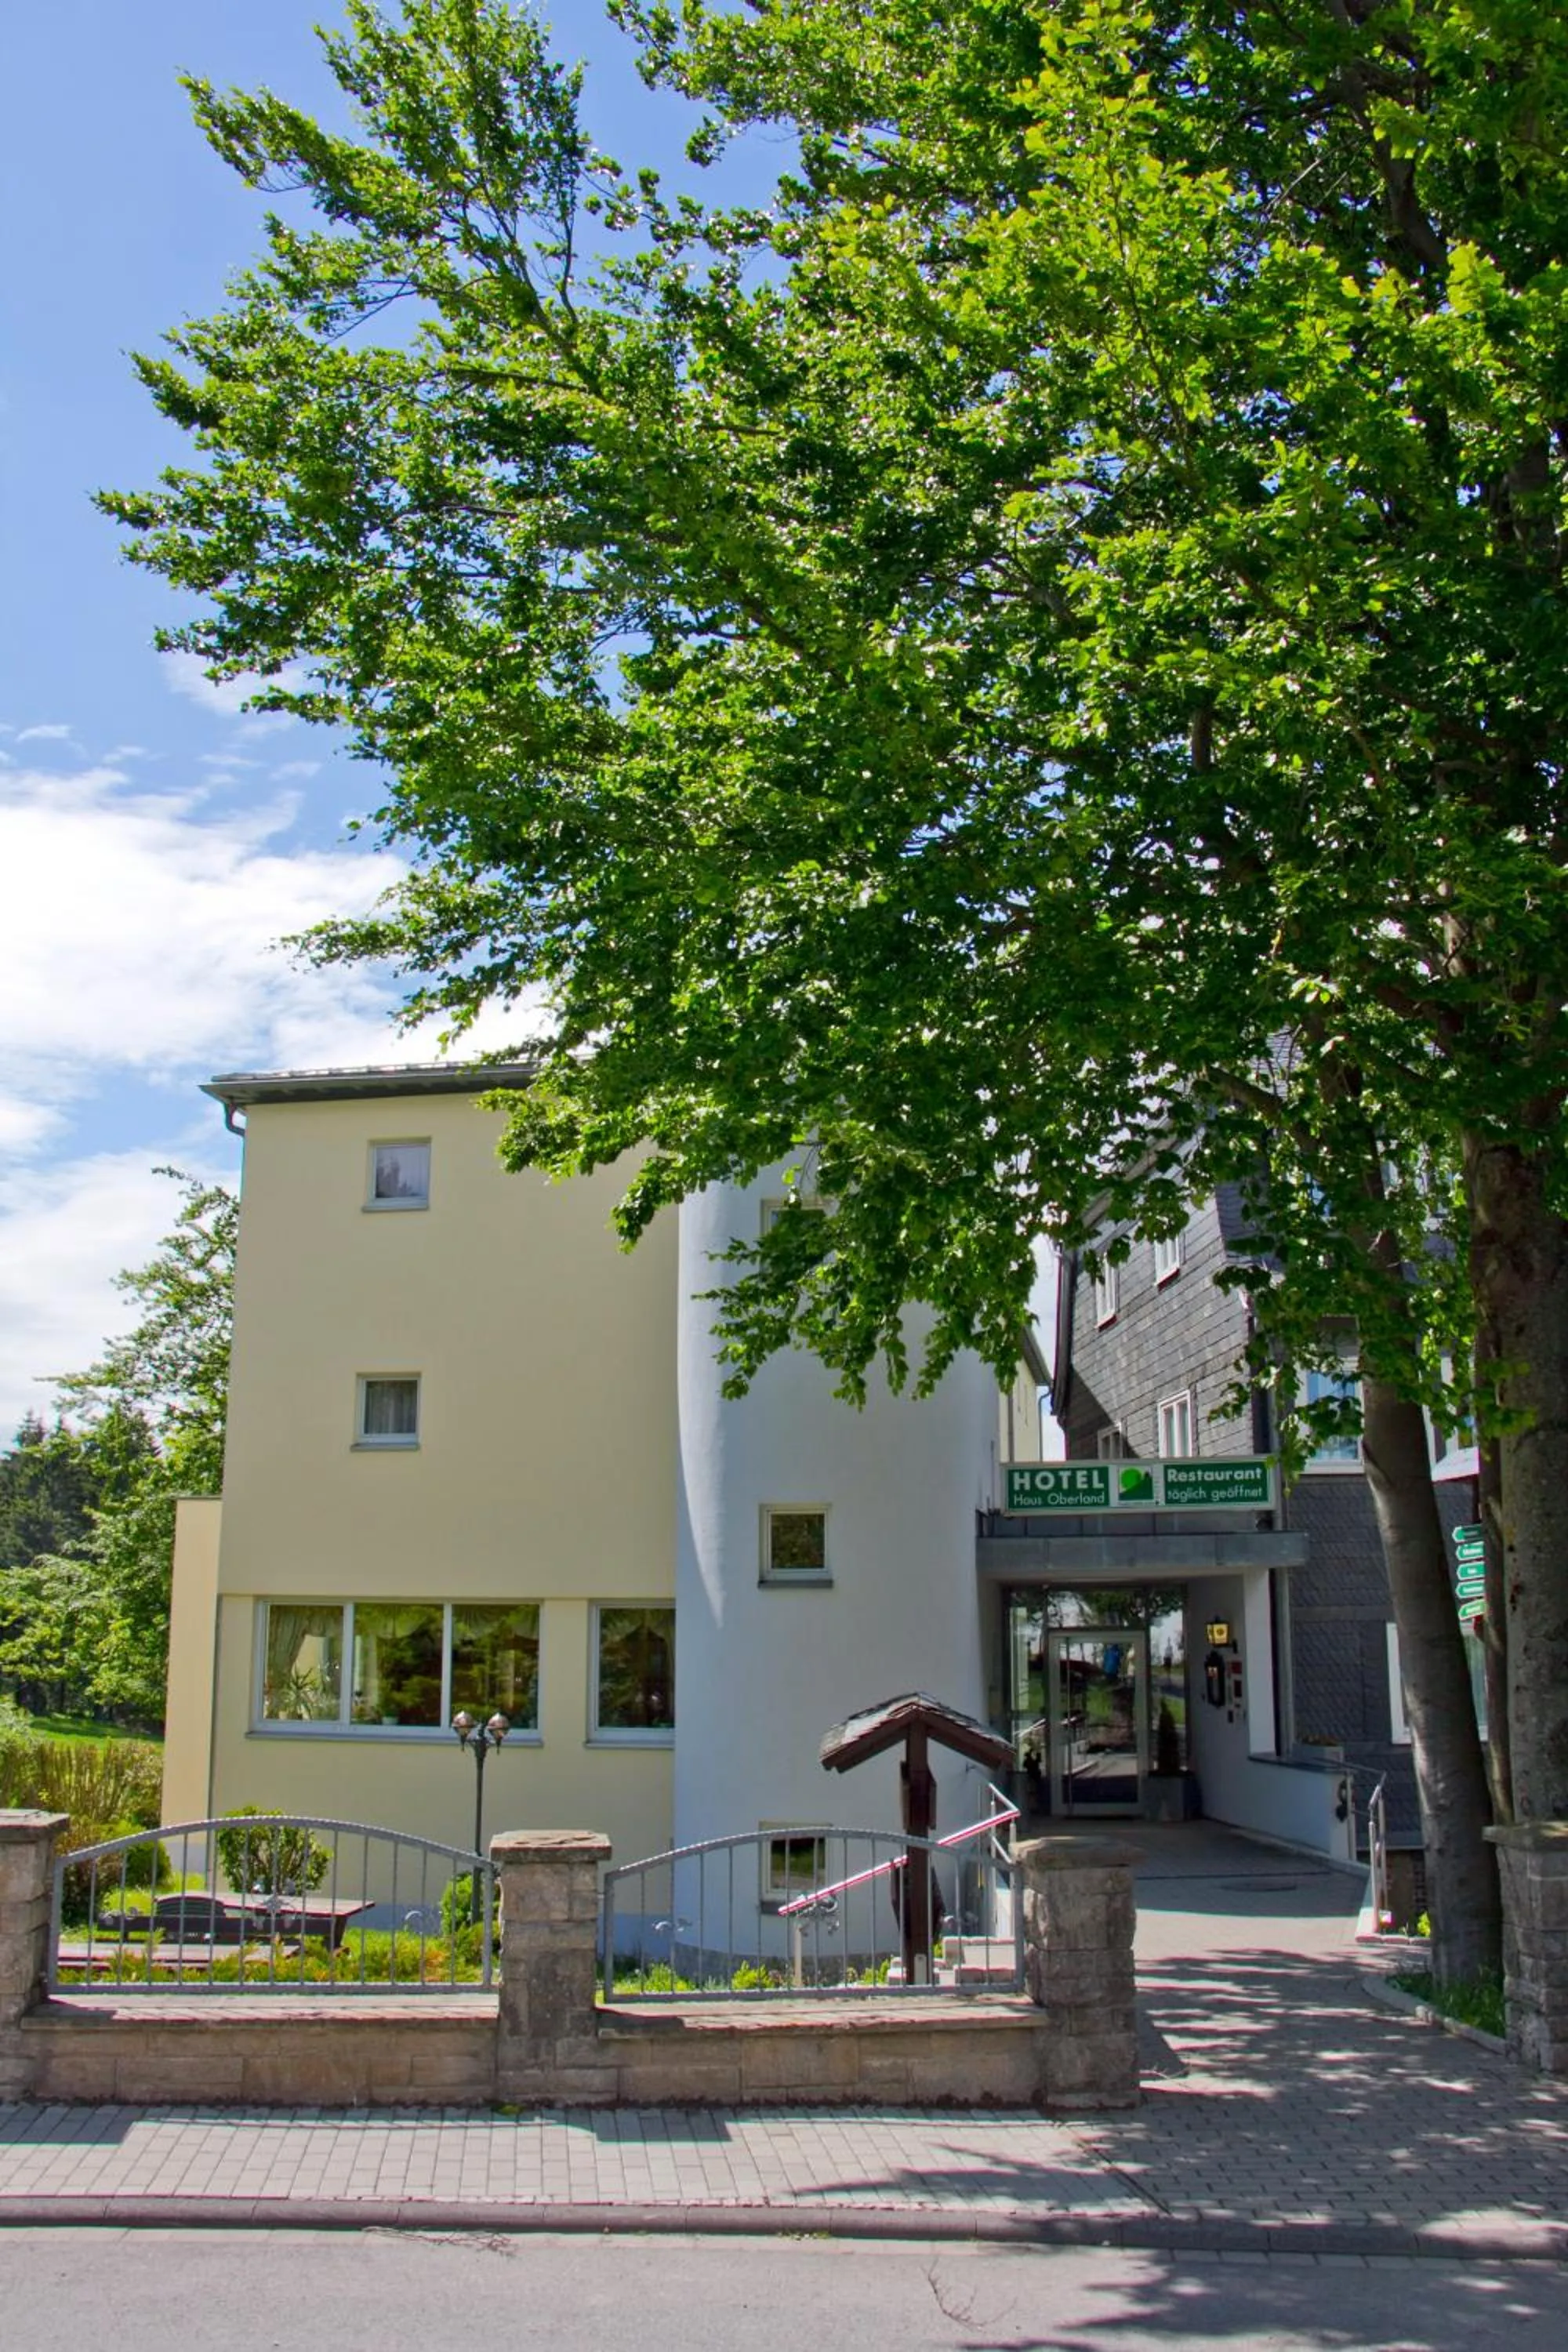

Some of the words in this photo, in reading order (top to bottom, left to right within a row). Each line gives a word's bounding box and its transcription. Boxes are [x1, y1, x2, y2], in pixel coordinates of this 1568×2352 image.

[1014, 1470, 1105, 1490] HOTEL
[1167, 1467, 1262, 1483] Restaurant
[1013, 1494, 1043, 1506] Haus
[1047, 1491, 1105, 1505] Oberland
[1210, 1484, 1262, 1501] geöffnet
